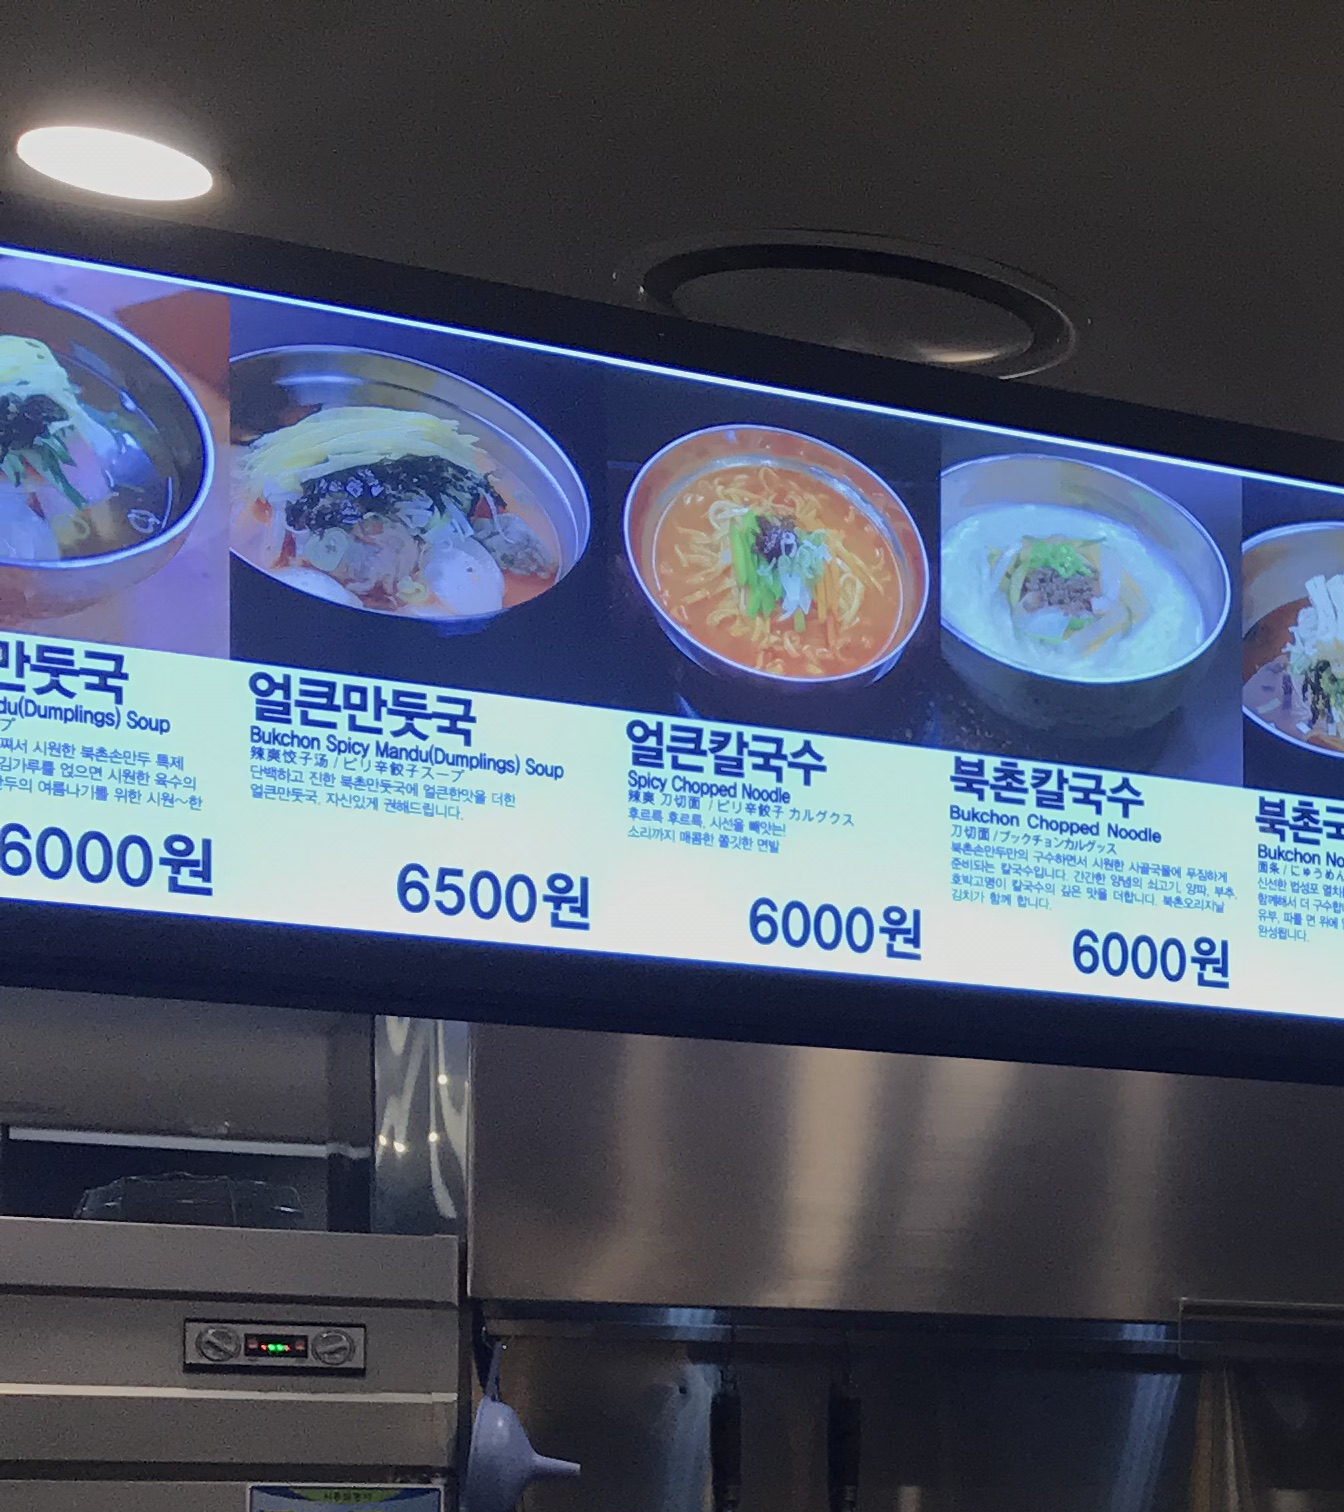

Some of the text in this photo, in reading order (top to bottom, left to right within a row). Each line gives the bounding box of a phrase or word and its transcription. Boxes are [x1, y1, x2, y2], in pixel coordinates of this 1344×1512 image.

[0, 640, 129, 705] 만둣국
[127, 711, 171, 735] Soup
[248, 671, 477, 748] 얼큰만둣국
[33, 740, 184, 771] 시원한 북촌손만두 특제
[250, 725, 564, 780] Bukchon Spicy Mandu(Dumplings) Soup
[626, 719, 827, 786] 얼큰칼국수
[38, 780, 108, 801] 여름나기를
[114, 788, 141, 805] 위한
[61, 762, 102, 781] 얹으면
[108, 768, 150, 786] 시원한
[155, 773, 197, 791] 육수의
[310, 771, 335, 788] 진한
[340, 774, 419, 798] 북촌만둣국에
[628, 769, 791, 804] Spicy Chopped Noodle
[950, 756, 1145, 819] 북촌칼국수
[326, 793, 378, 811] 자신있게
[628, 825, 780, 854] 소리까지 매콤한 쫄깃한 면발
[710, 816, 744, 833] 시선을
[950, 805, 1162, 843] Bukchon Chopped Noodle
[0, 823, 213, 896] 6000원
[1033, 850, 1088, 867] 구수하면서
[1093, 857, 1124, 872] 시원한
[1128, 861, 1182, 879] 사골국물에
[1186, 868, 1228, 883] 푸짐하게
[1258, 843, 1321, 866] Bukchon
[397, 862, 591, 931] 6500원
[952, 889, 985, 904] 김치가
[990, 892, 1012, 906] 함께
[1258, 877, 1287, 892] 신선한
[749, 897, 922, 961] 6000원
[1072, 928, 1230, 989] 6000원
